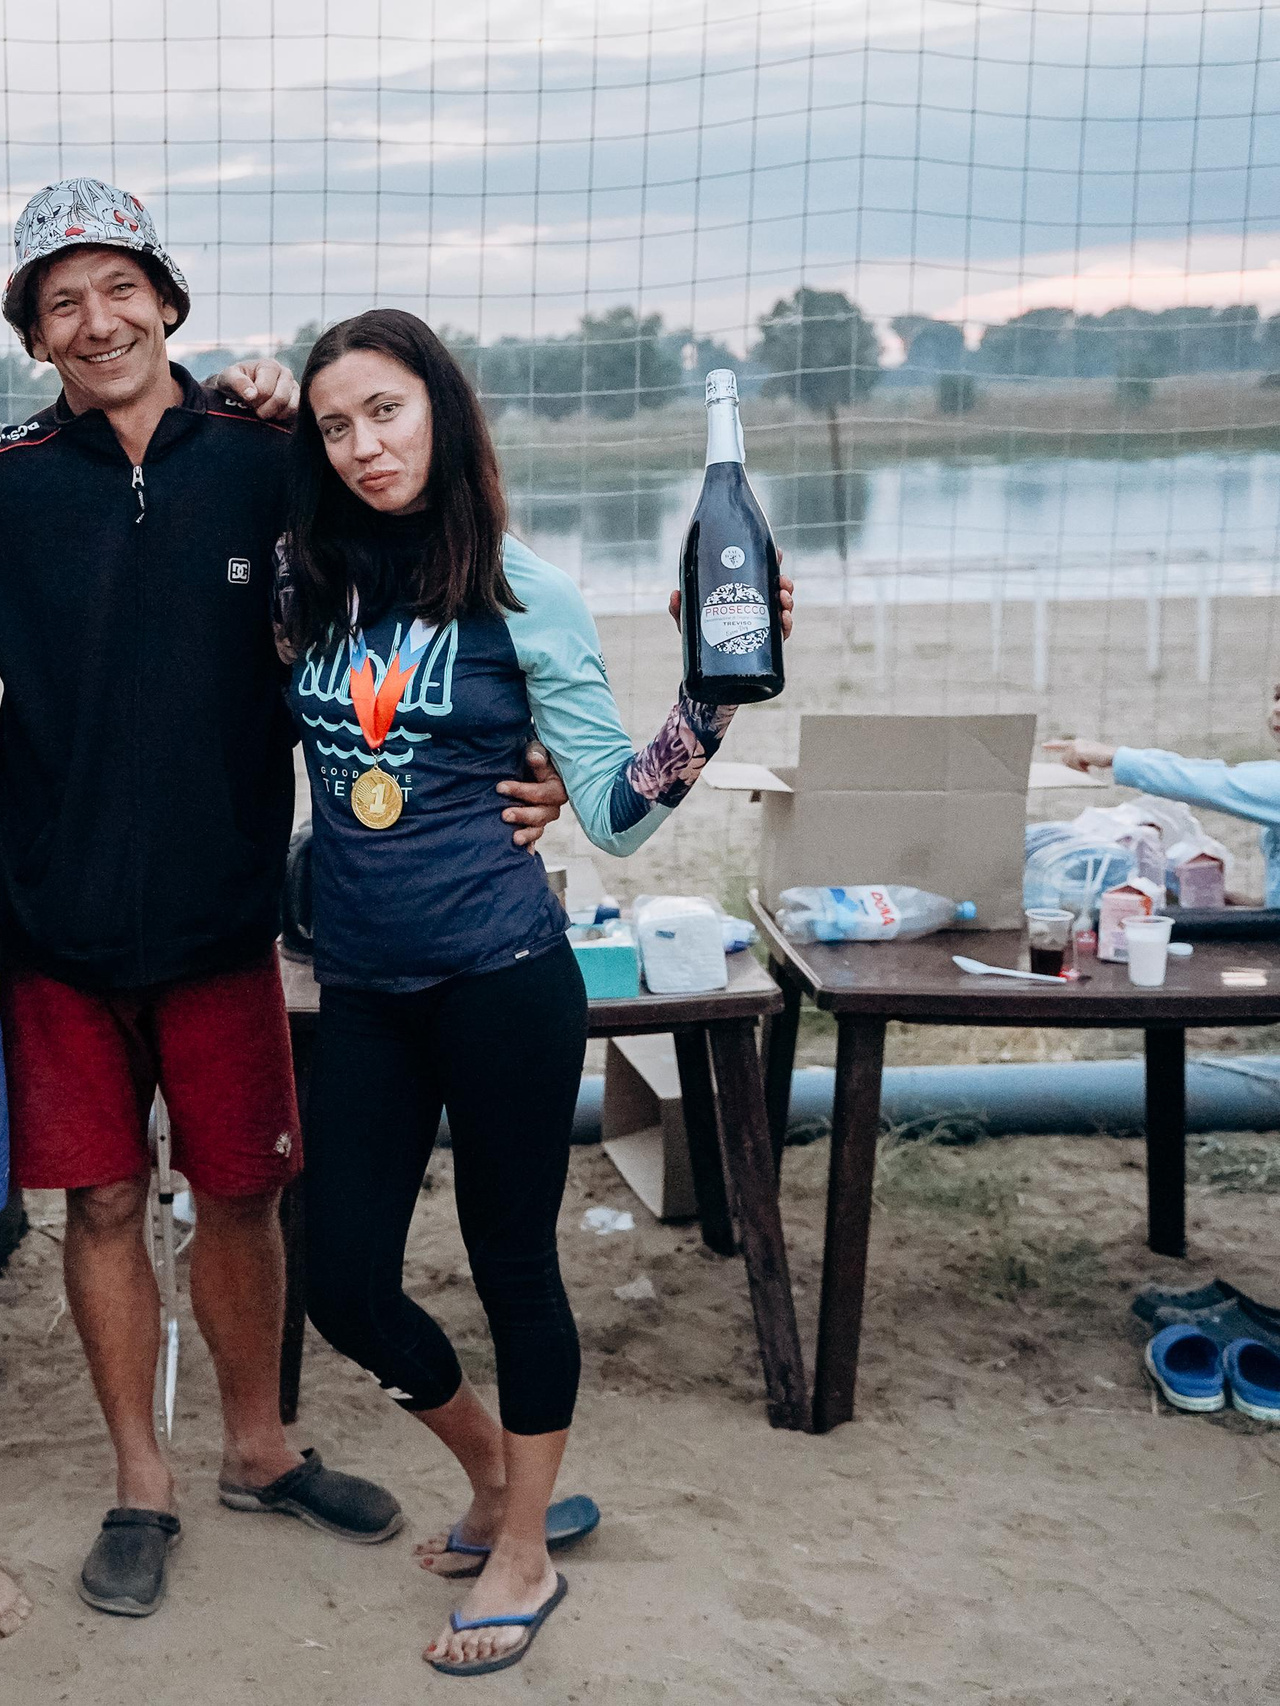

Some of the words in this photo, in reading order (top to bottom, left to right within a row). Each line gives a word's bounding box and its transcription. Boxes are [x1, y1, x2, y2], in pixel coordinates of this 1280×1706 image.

[231, 562, 247, 579] DC
[705, 605, 765, 616] PROSECCO
[320, 766, 360, 779] GOOD
[369, 783, 387, 813] 1
